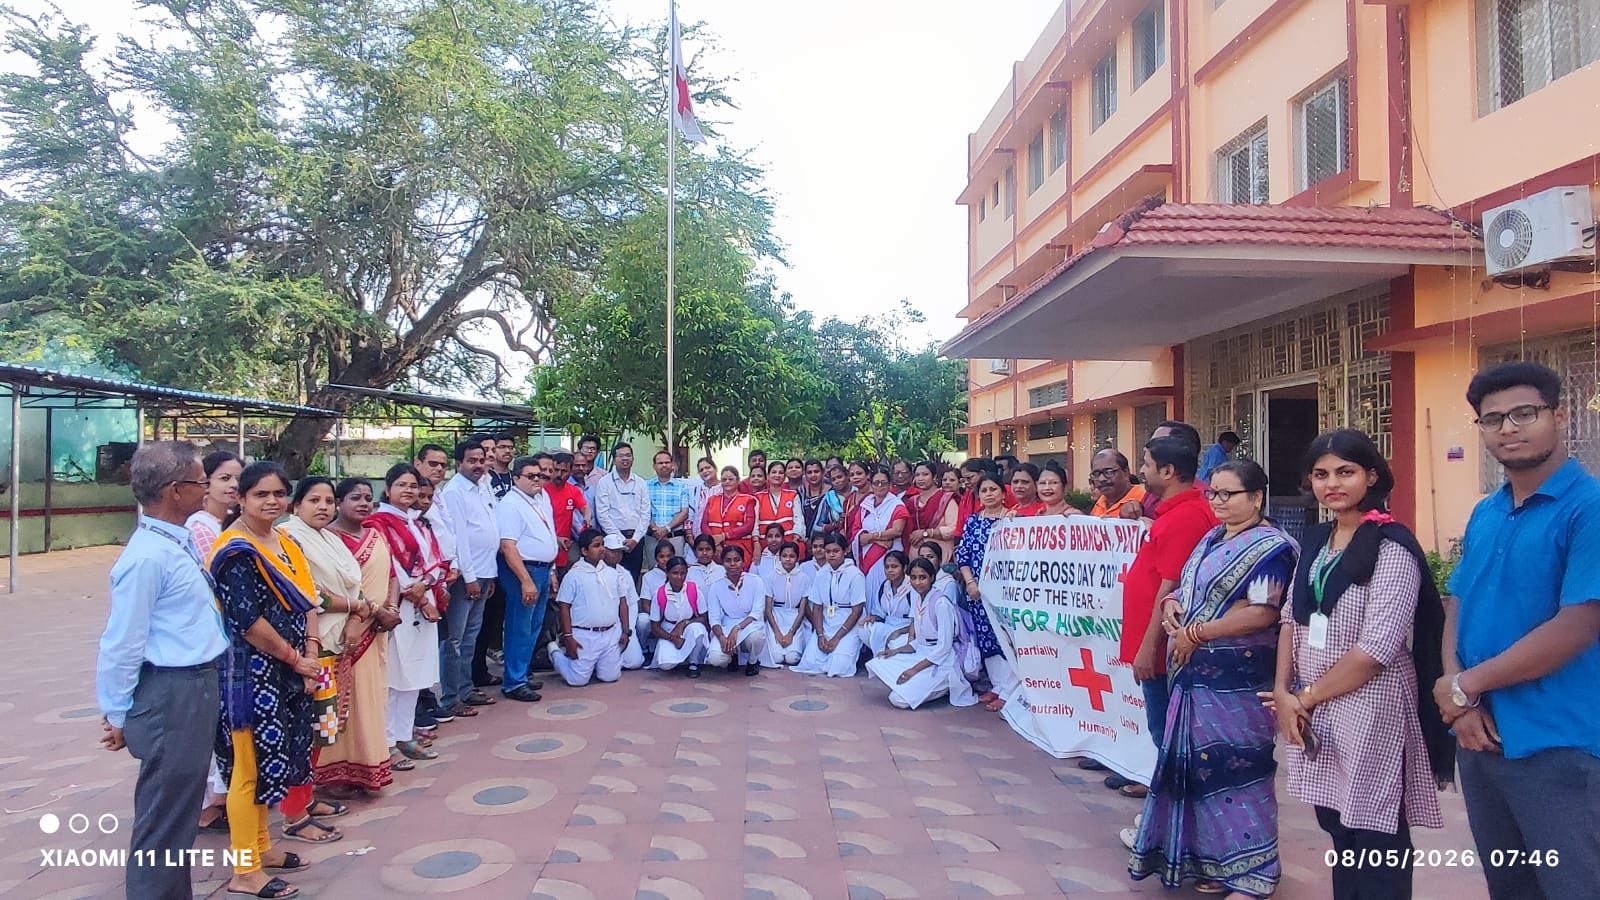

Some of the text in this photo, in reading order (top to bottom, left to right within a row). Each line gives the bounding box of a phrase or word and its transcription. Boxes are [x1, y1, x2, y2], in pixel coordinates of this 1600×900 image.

[1028, 524, 1067, 550] CROSS
[1030, 560, 1075, 585] CROSS
[1078, 562, 1096, 588] DAY
[1023, 587, 1040, 603] OF
[1045, 588, 1068, 606] THE
[1071, 591, 1095, 610] YEAR
[1011, 608, 1049, 633] FOR
[1017, 644, 1058, 659] partiality
[1025, 677, 1061, 689] Service
[1078, 720, 1118, 743] Humanity
[1120, 715, 1139, 735] Unity
